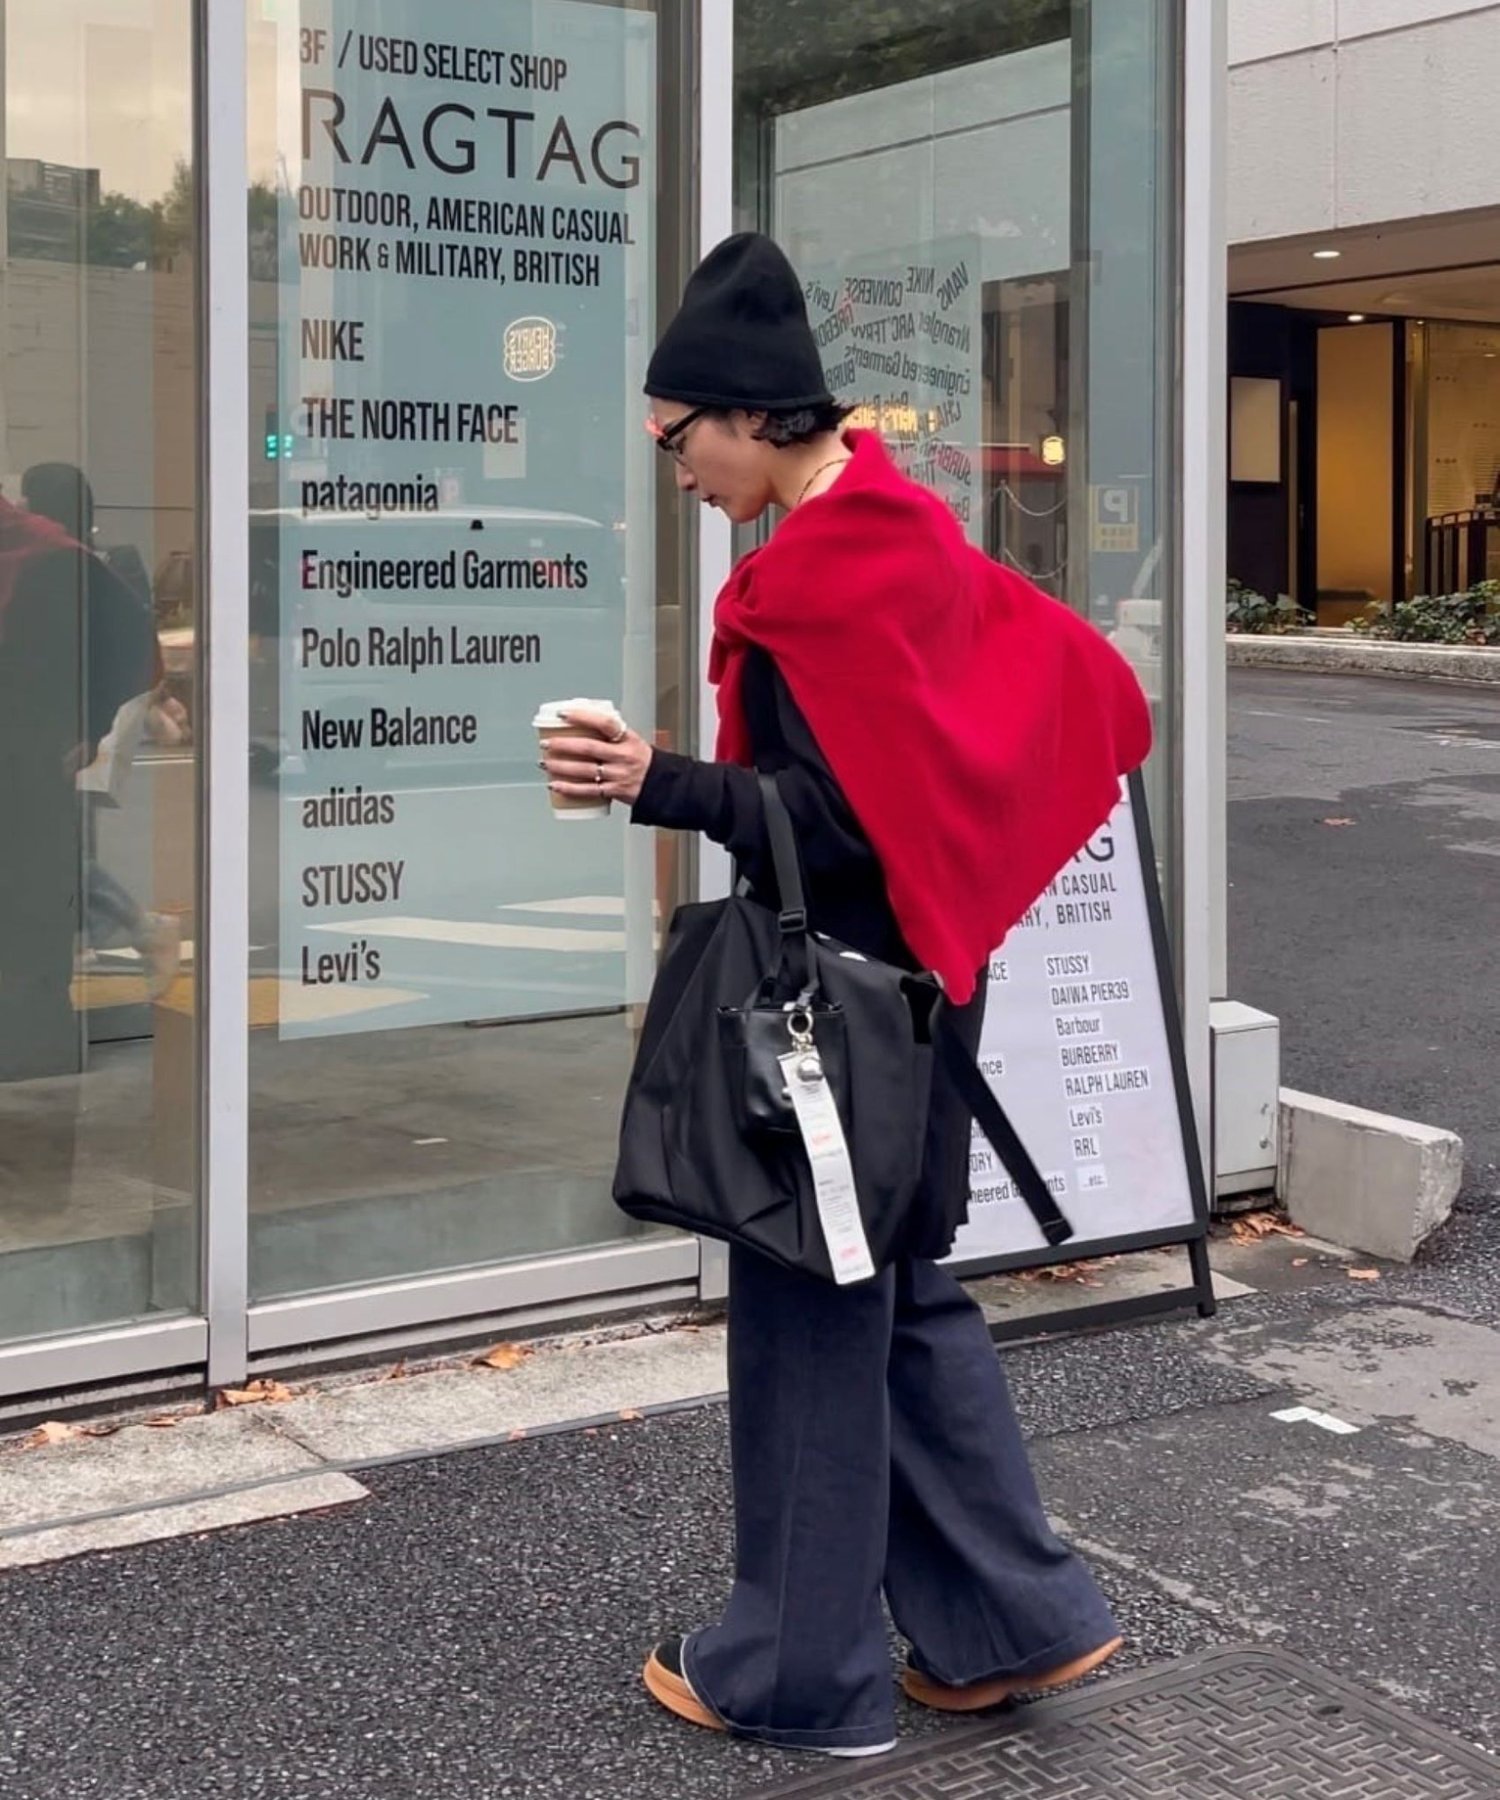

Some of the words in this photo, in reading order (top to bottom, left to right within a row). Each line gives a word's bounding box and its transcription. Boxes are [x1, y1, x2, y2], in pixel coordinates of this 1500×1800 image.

[300, 28, 326, 64] 3F
[359, 34, 417, 75] USED
[424, 43, 504, 85] SELECT
[510, 55, 567, 92] SHOP
[301, 88, 640, 189] RAGTAG
[301, 187, 419, 233] OUTDOOR,
[427, 197, 544, 238] AMERICAN
[553, 207, 635, 245] CASUAL
[301, 232, 371, 271] WORK
[377, 243, 389, 269] &
[396, 240, 506, 285] MILITARY,
[513, 249, 600, 287] BRITISH
[301, 318, 364, 361] NIKE
[302, 397, 355, 439] THE
[362, 400, 449, 442] NORTH
[458, 404, 519, 444] FACE
[302, 474, 439, 520] patagonia
[302, 549, 455, 598] Engineered
[463, 549, 588, 589] Garments
[302, 627, 360, 668] Polo
[368, 626, 443, 673] Ralph
[451, 627, 540, 664] Lauren
[302, 709, 363, 751] New
[370, 707, 477, 747] Balance
[302, 786, 395, 828] adidas
[302, 861, 404, 906] STUSSY
[1062, 872, 1117, 896] CASUAL
[1056, 901, 1112, 926] BRITISH
[302, 940, 380, 985] Levi's
[1047, 956, 1091, 977] STUSSY
[1052, 985, 1088, 1006] DAIWA
[1092, 981, 1129, 1001] PIER39
[1056, 1016, 1100, 1036] Barbour
[1061, 1043, 1119, 1067] BURBERRY
[1065, 1075, 1102, 1097] RALPH
[1106, 1069, 1149, 1093] LAUREN
[1074, 1138, 1098, 1157] RRL
